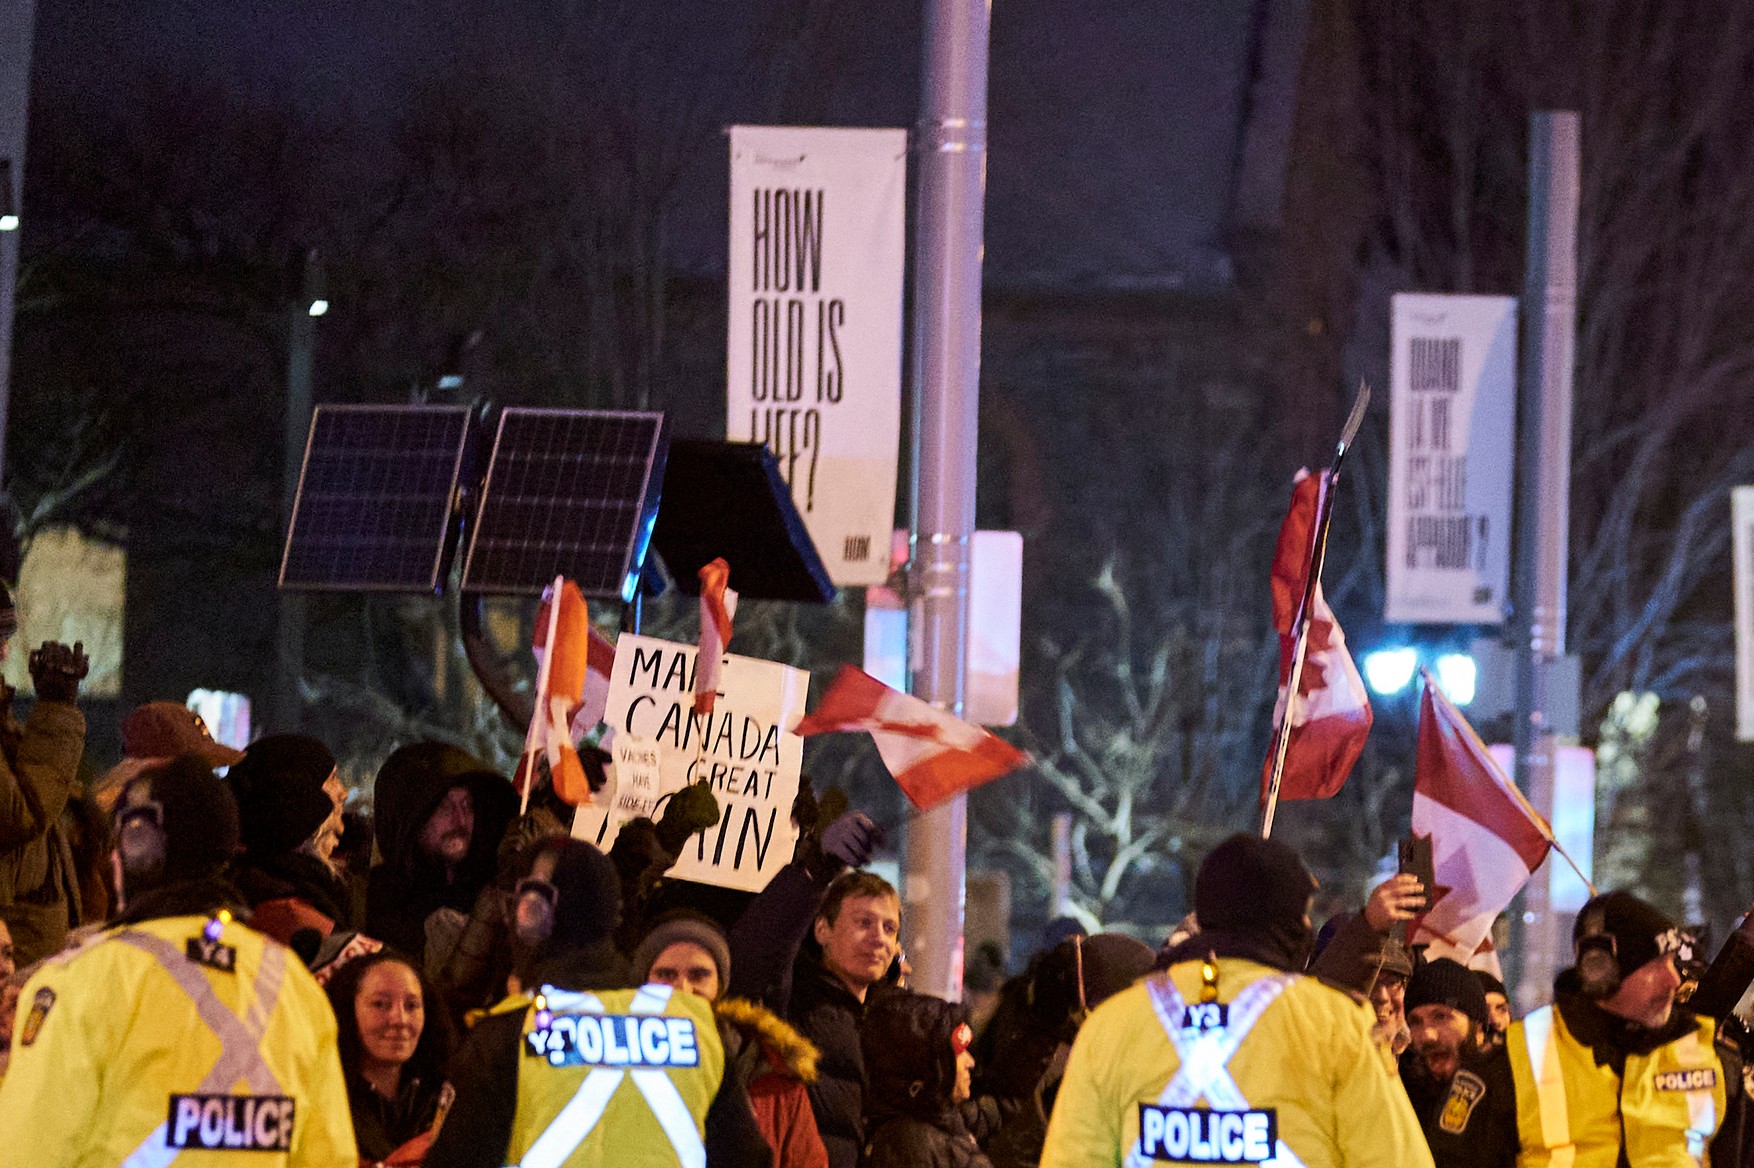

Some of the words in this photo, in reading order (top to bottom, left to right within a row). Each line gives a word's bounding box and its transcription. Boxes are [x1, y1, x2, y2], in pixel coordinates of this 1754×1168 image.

[753, 188, 824, 292] HOW
[753, 297, 804, 402] OLD
[817, 297, 845, 404] IS
[629, 647, 729, 697] MA
[625, 694, 780, 767] CANADA
[1655, 1069, 1714, 1091] POLICE
[1142, 1107, 1269, 1161] POLICE
